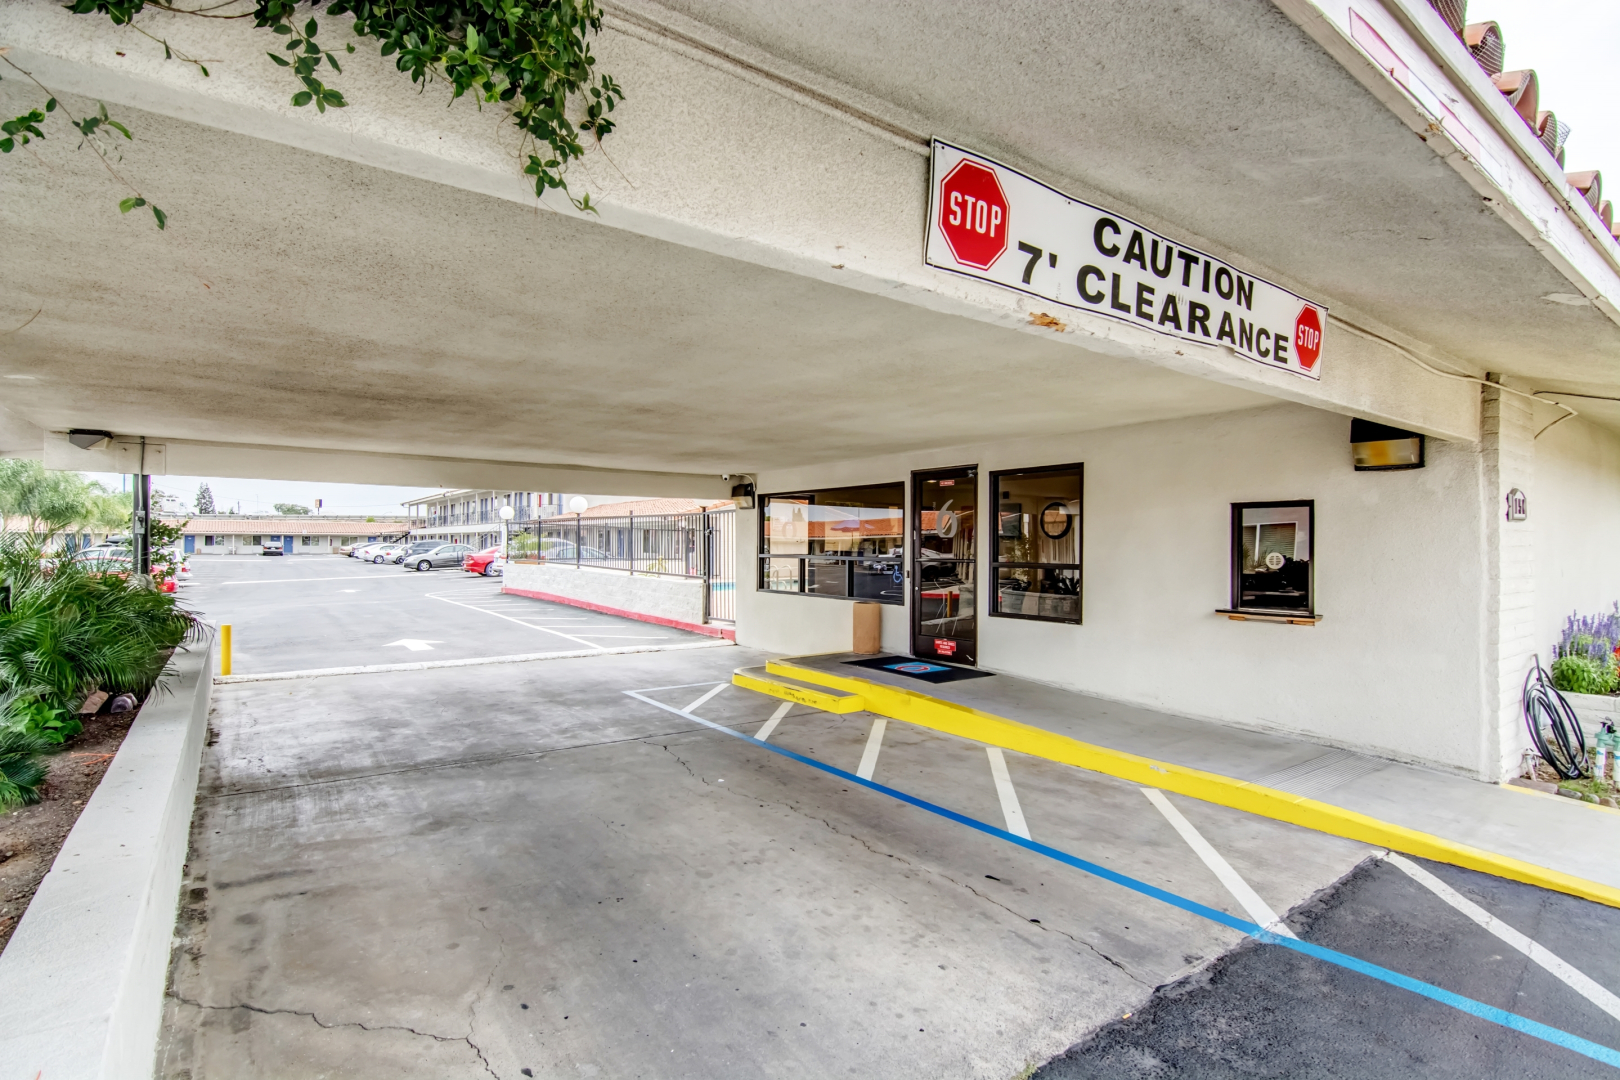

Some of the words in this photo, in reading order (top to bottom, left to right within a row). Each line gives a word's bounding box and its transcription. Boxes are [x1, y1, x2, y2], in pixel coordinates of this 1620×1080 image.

[949, 191, 1002, 238] STOP
[1093, 217, 1254, 311] CAUTION
[1018, 240, 1057, 285] 7'
[1076, 264, 1289, 364] CLEARANCE
[1297, 322, 1320, 352] STOP
[936, 499, 957, 538] 6
